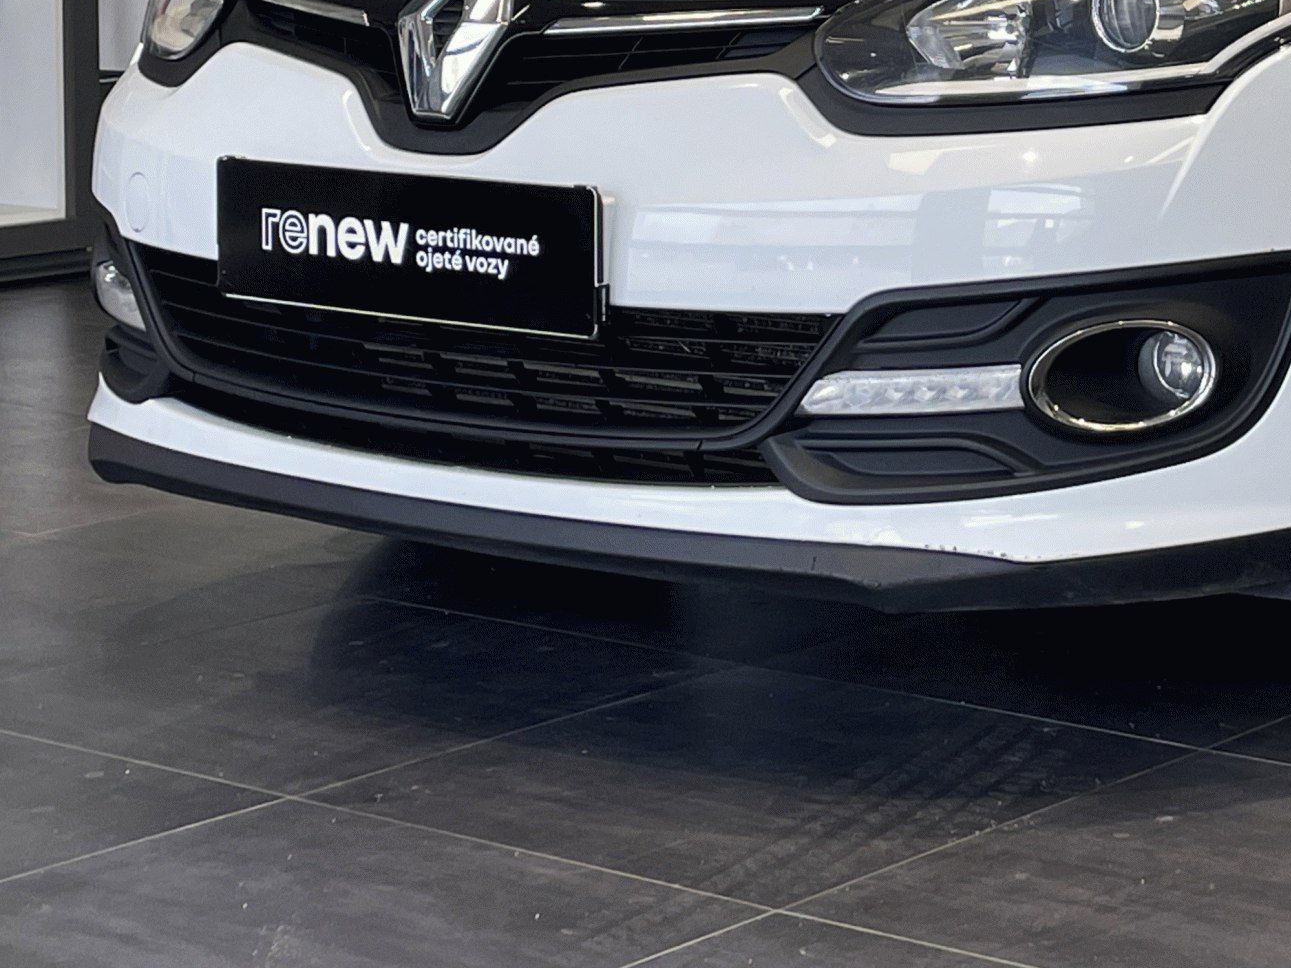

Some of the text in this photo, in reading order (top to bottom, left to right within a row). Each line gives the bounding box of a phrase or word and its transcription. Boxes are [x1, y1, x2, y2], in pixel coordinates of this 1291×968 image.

[261, 207, 409, 265] renew
[415, 226, 541, 257] certifikované
[415, 247, 510, 280] ojeté vozy
